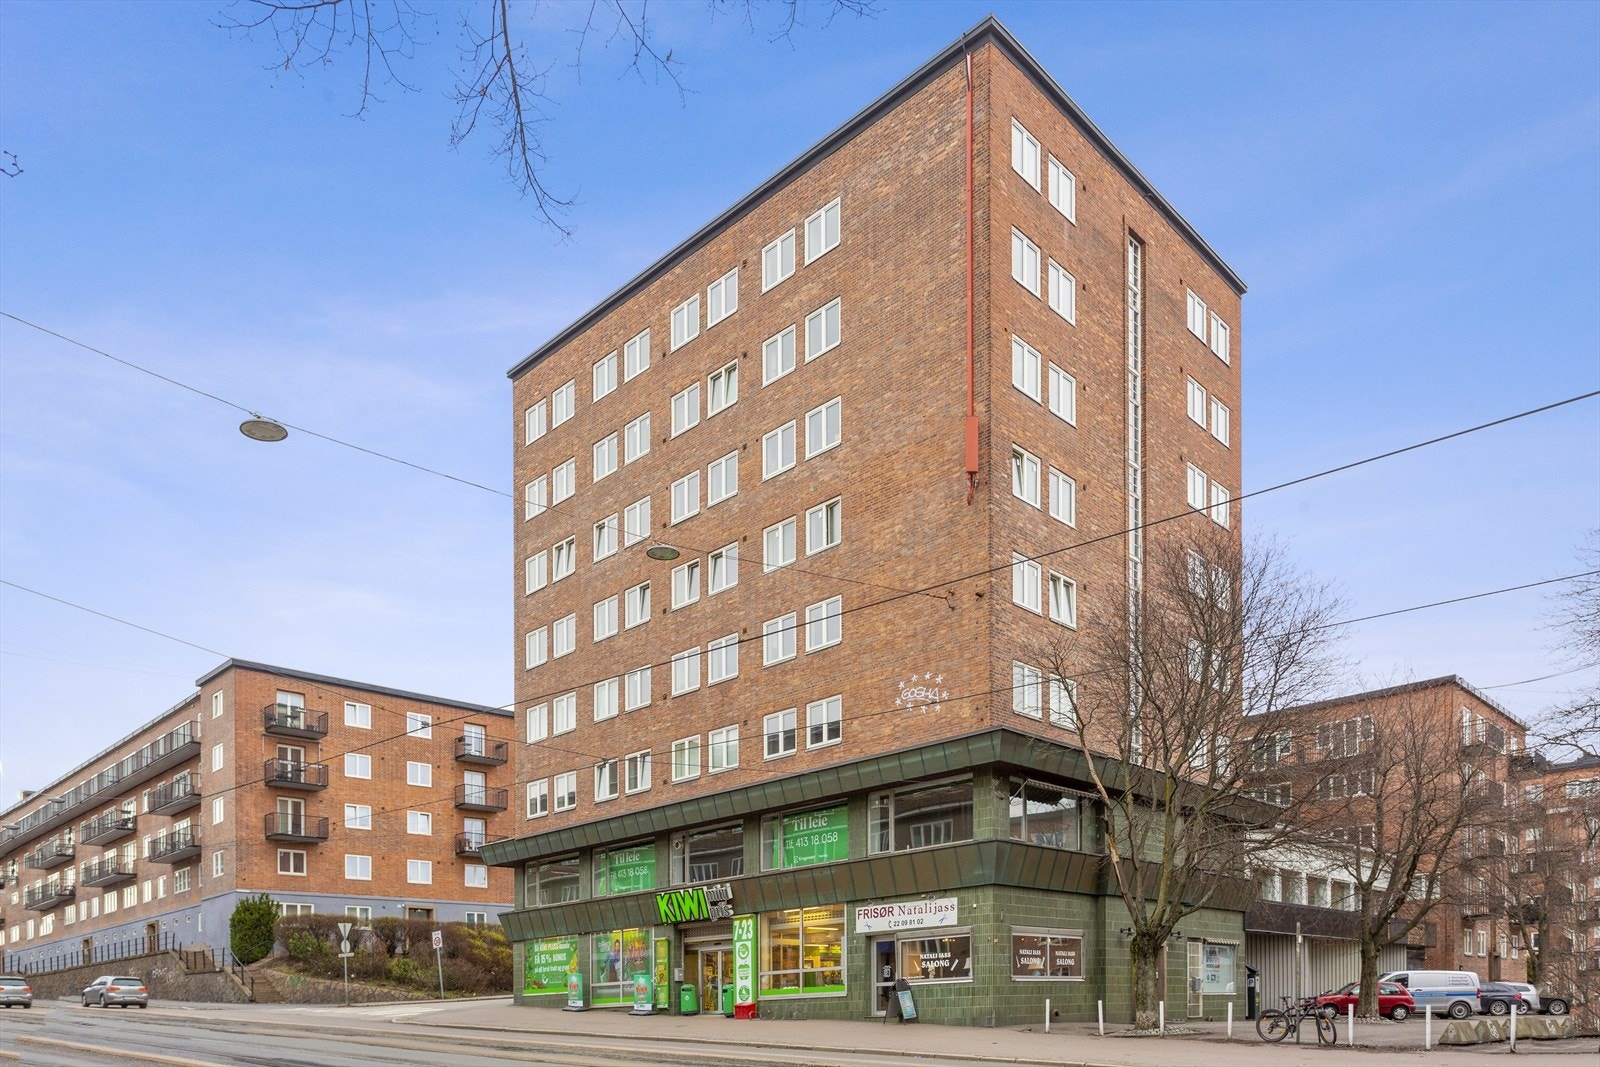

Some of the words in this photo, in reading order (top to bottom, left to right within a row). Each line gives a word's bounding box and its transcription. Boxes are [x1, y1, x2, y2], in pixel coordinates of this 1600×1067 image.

[792, 816, 807, 831] Til
[809, 814, 828, 829] leie
[796, 836, 808, 847] 413
[811, 834, 819, 845] 18
[821, 831, 838, 844] 058
[635, 865, 648, 876] 058
[706, 883, 733, 902] mini
[655, 887, 710, 923] KIWI
[709, 902, 734, 922] pris
[857, 906, 895, 920] FRISØR
[734, 919, 753, 940] 7-23
[921, 959, 950, 968] SALONG
[1056, 958, 1075, 966] SALONG
